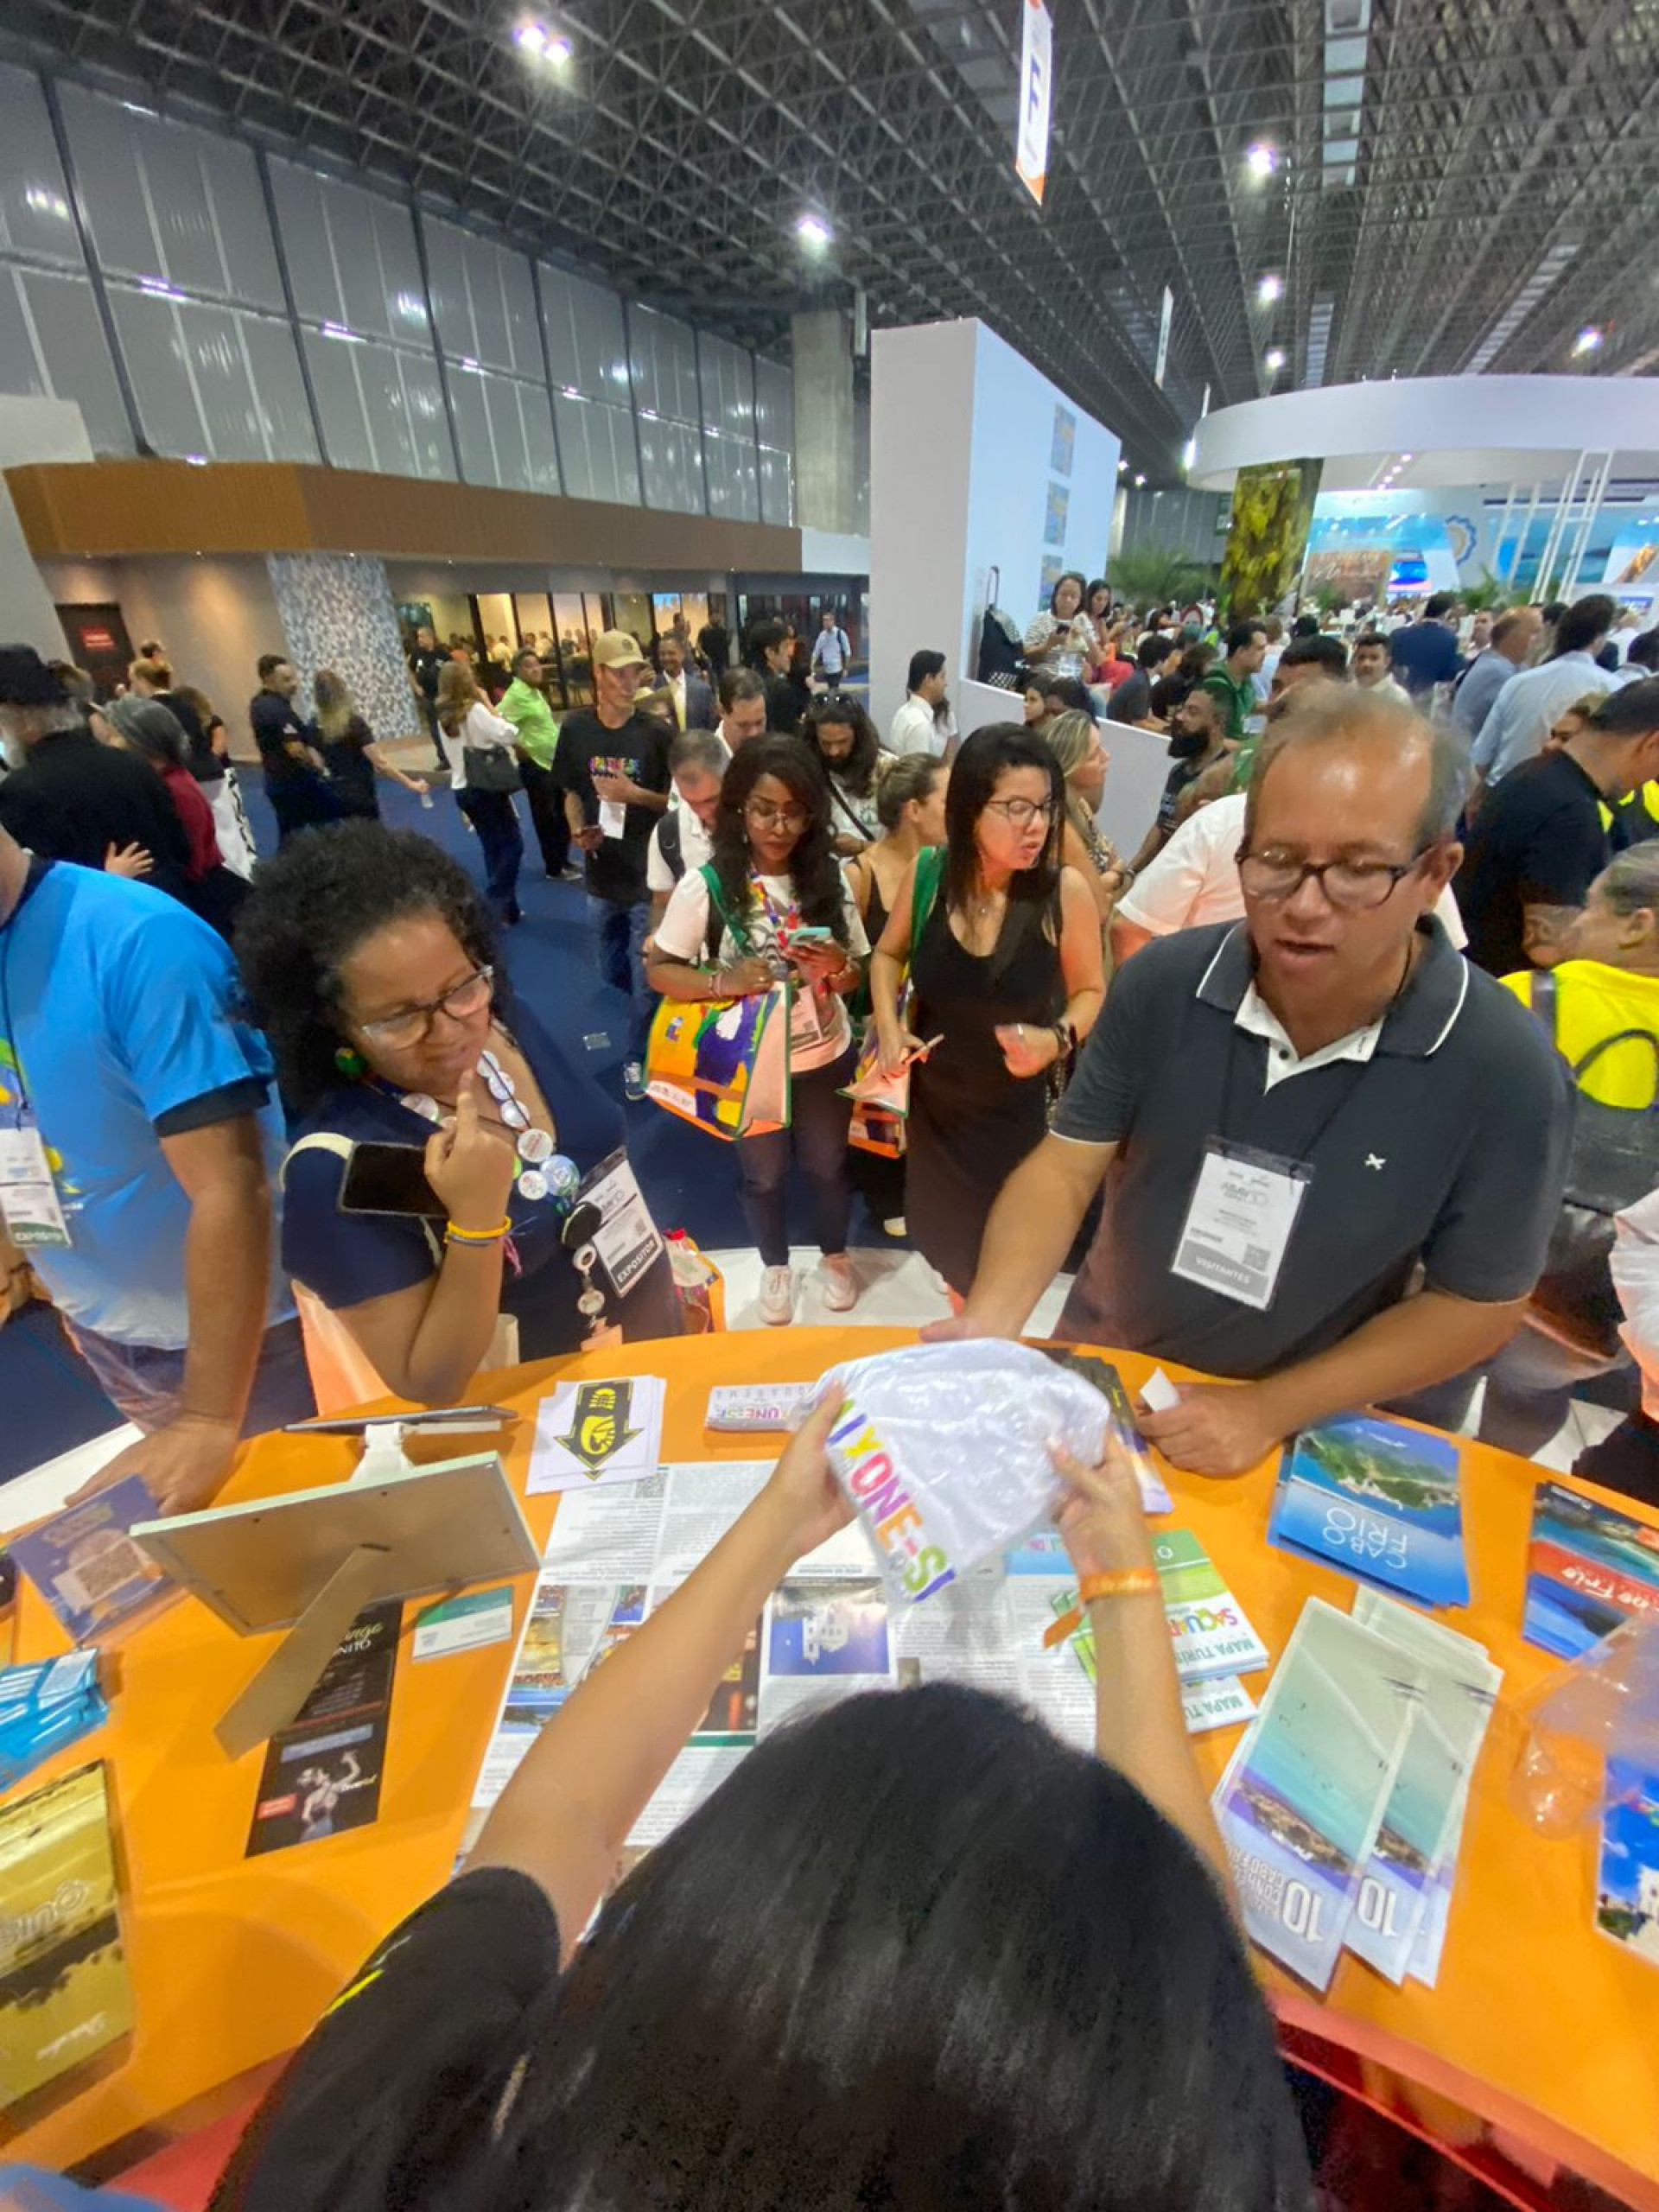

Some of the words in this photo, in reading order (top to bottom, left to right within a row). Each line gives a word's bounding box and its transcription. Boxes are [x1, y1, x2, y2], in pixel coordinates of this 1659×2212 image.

[1195, 1255, 1251, 1285] VISITANTES
[1322, 1525, 1408, 1569] CABO
[1326, 1506, 1408, 1554] FRIO
[1215, 1637, 1255, 1656] MAPA
[1205, 1694, 1243, 1714] MAPA
[1282, 1878, 1324, 1942] 10
[1357, 1876, 1398, 1936] 10
